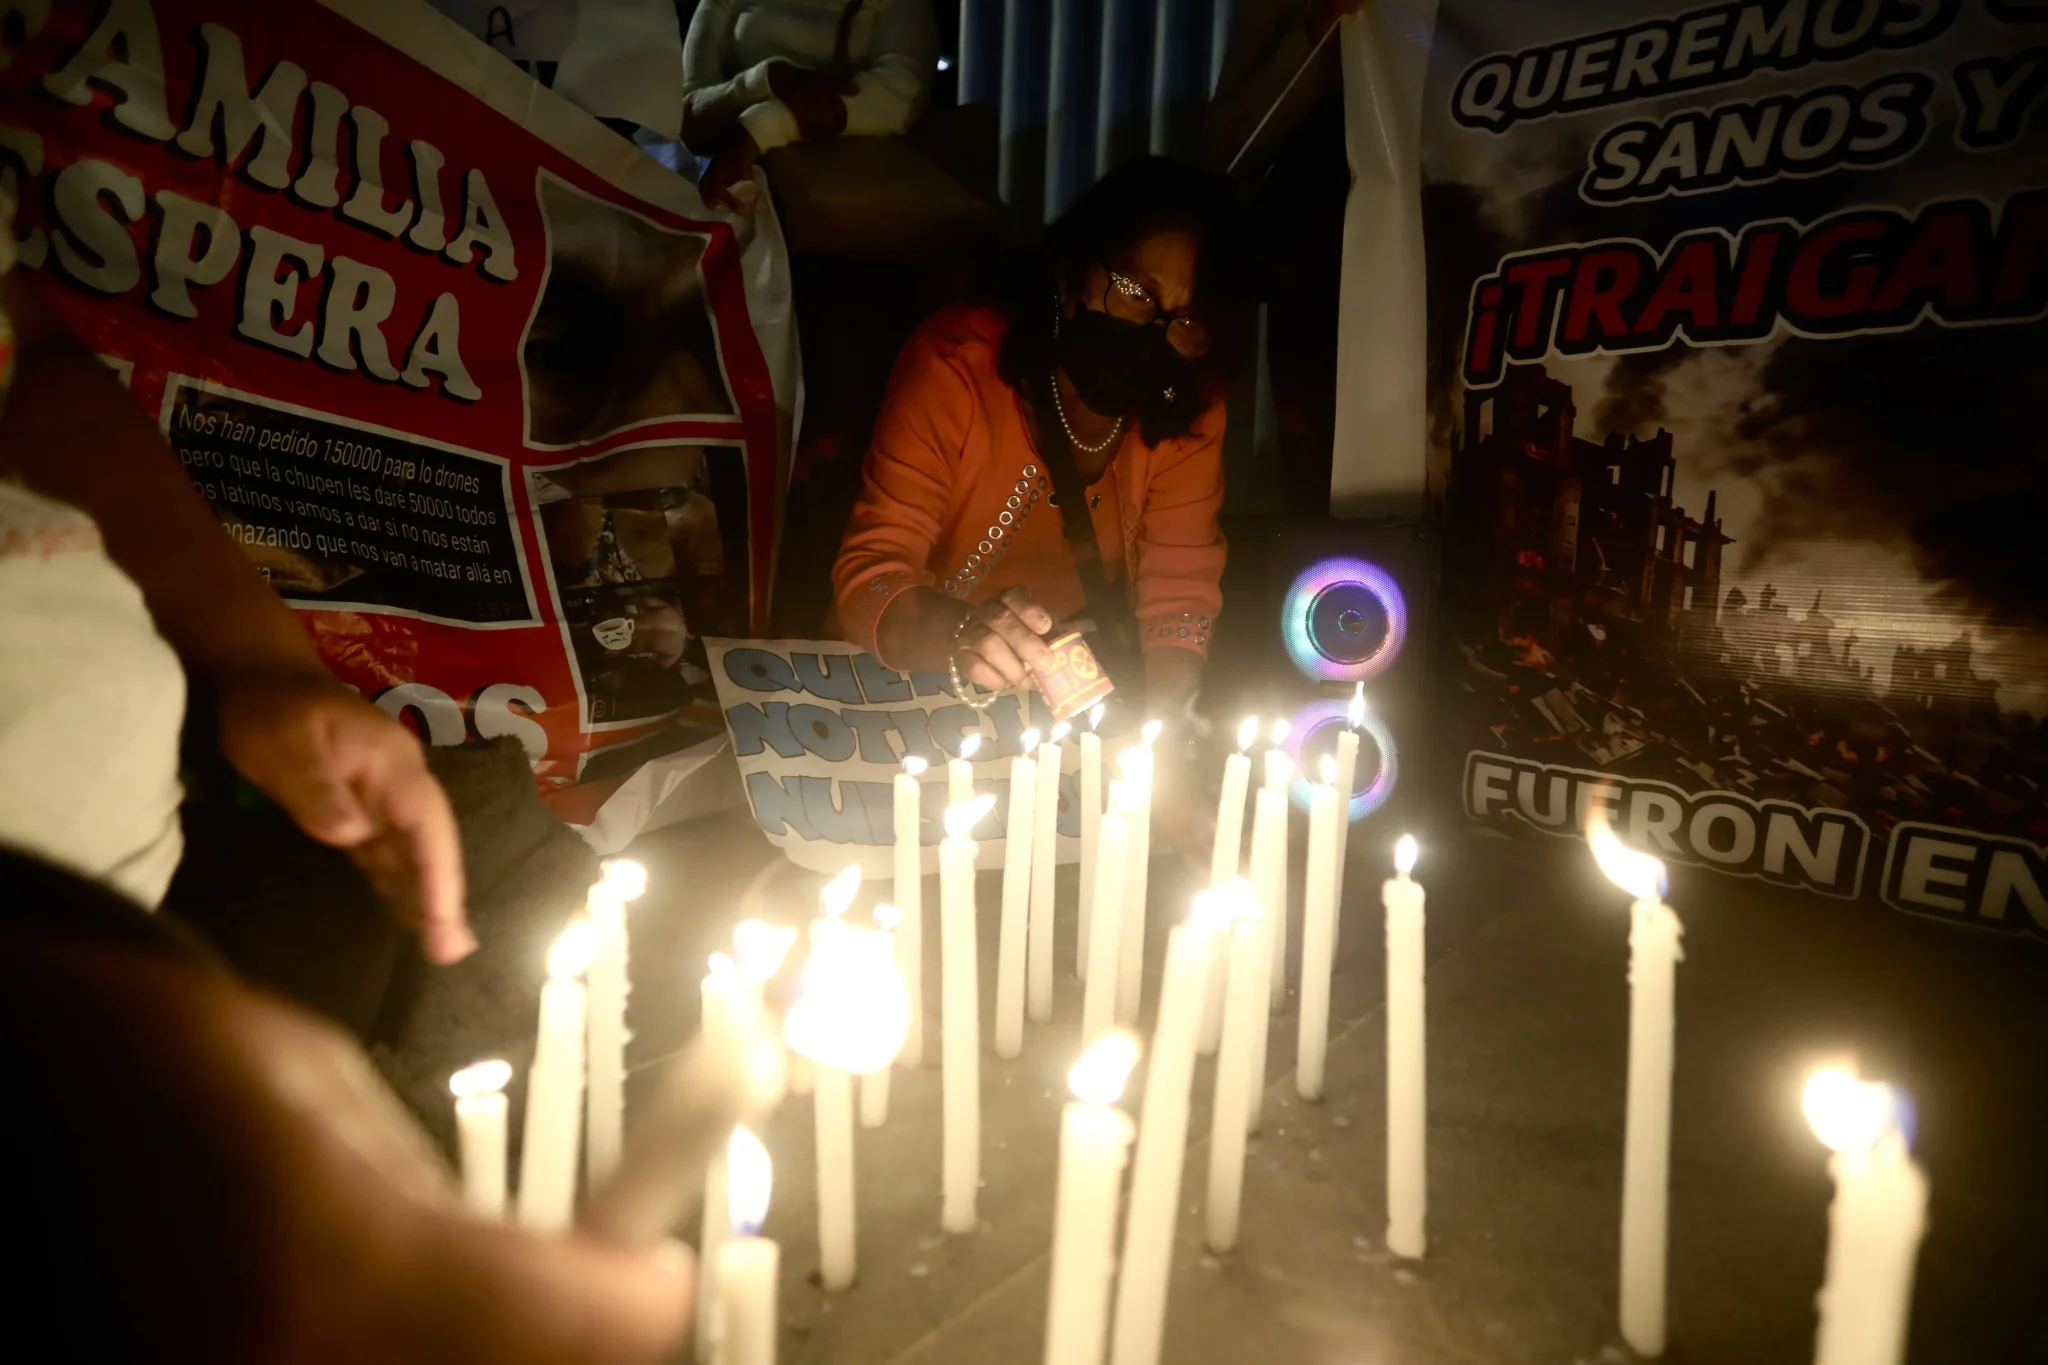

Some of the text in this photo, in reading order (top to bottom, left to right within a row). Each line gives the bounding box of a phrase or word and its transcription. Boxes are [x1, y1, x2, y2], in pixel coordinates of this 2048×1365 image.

[1592, 58, 2041, 192] SANOS Y
[179, 402, 480, 495] Nos han pedido 150000 para lo drones
[179, 447, 497, 526] pero que la chupen les daré 50000 todos
[192, 479, 491, 555] os latinos vamos a dar si no nos están
[316, 532, 348, 559] que
[350, 540, 379, 562] nos
[381, 547, 408, 569] van
[420, 558, 462, 581] matar
[465, 561, 492, 584] allá
[493, 568, 513, 585] en
[1471, 761, 1847, 886] FUERON
